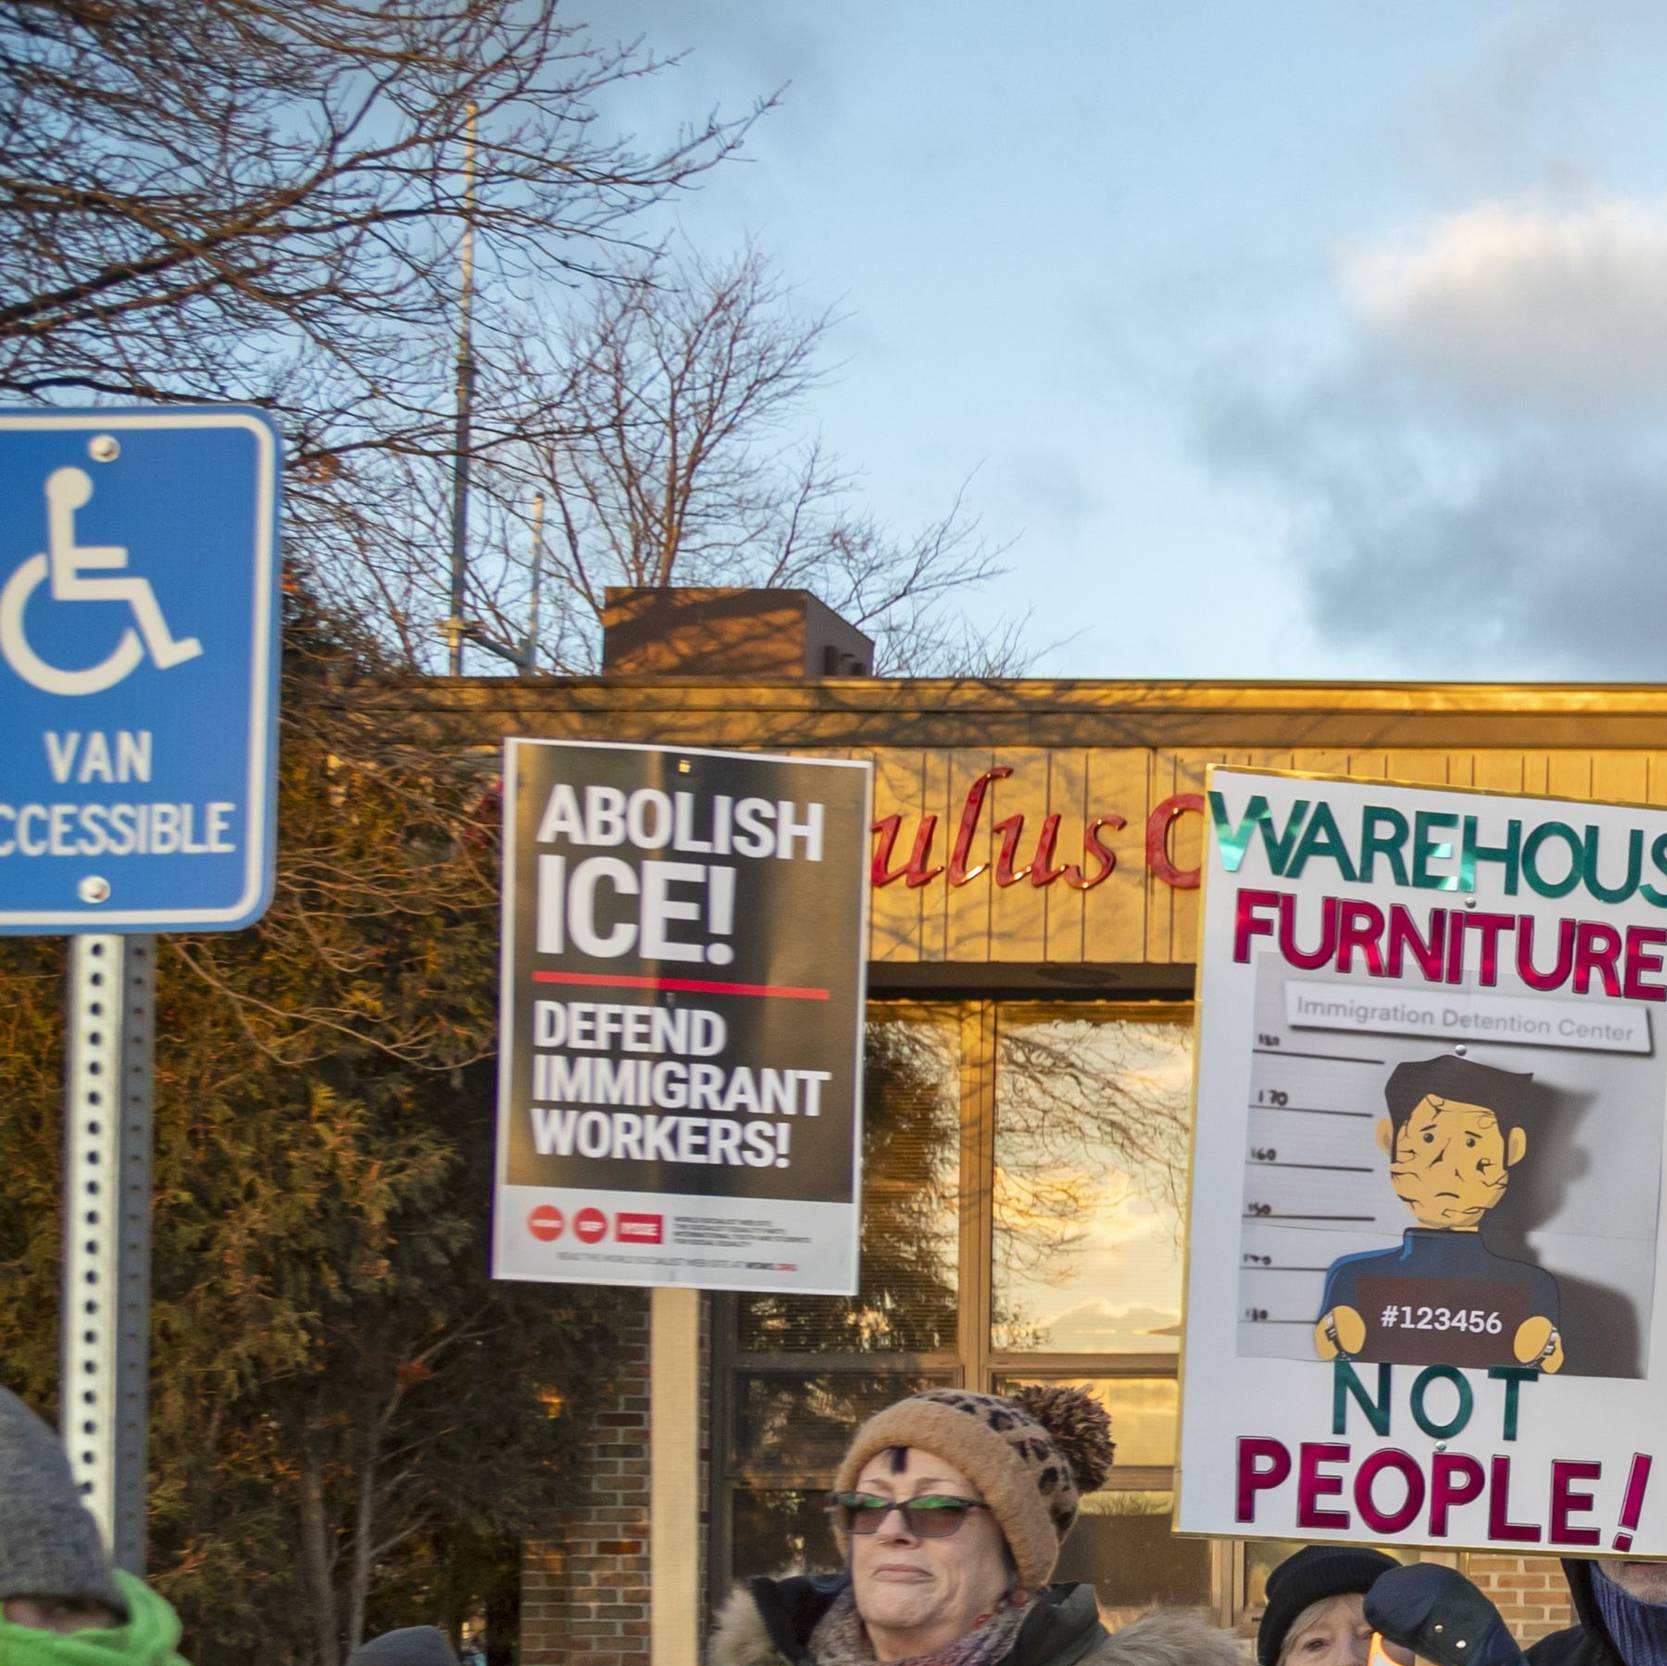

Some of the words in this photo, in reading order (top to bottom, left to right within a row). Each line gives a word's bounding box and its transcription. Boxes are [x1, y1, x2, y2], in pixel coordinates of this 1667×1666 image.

[43, 731, 153, 784] VAN
[536, 783, 825, 861] ABOLISH
[536, 853, 737, 966] ICE!
[534, 1000, 728, 1057] DEFEND
[1297, 997, 1435, 1026] Immigration
[1442, 1010, 1551, 1034] Detention
[1558, 1019, 1634, 1042] Center
[533, 1054, 832, 1117] IMMIGRANT
[1258, 1089, 1288, 1106] 170
[530, 1108, 792, 1168] WORKERS!
[1250, 1147, 1277, 1161] 160
[1380, 1303, 1503, 1335] #123456
[1332, 1360, 1540, 1442] NOT
[1234, 1435, 1654, 1552] PEOPLE!
